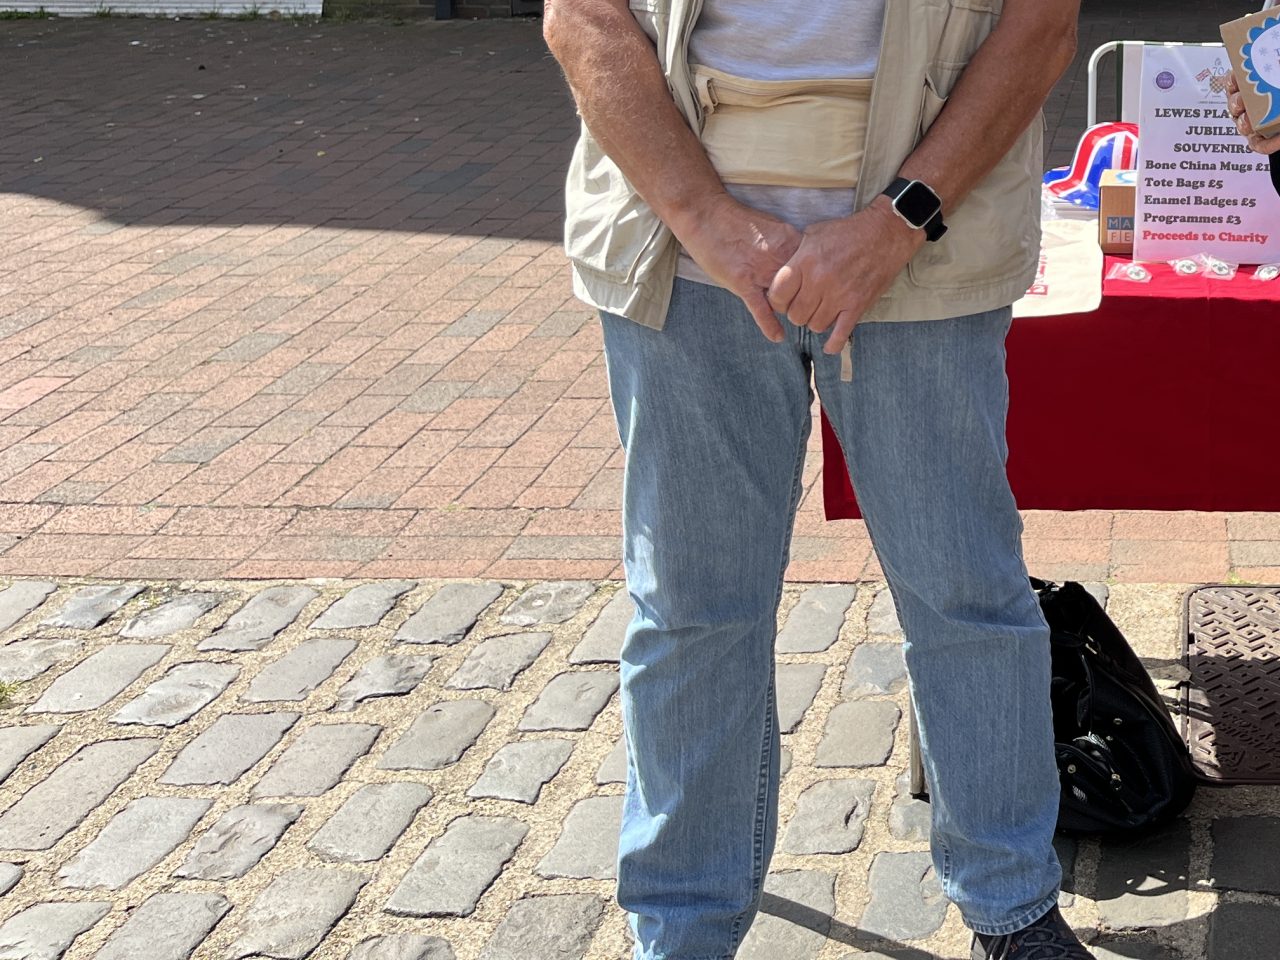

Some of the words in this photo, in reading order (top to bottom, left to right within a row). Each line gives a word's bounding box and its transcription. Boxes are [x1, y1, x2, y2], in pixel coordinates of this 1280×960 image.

[1155, 107, 1201, 119] LEWES
[1203, 108, 1230, 119] PLA
[1173, 142, 1254, 154] SOUVENIRS
[1145, 159, 1177, 170] Bone
[1179, 160, 1217, 171] China
[1219, 161, 1253, 173] Mugs
[1255, 162, 1271, 172] £1
[1144, 177, 1174, 188] Tote
[1176, 178, 1206, 190] Bags
[1208, 179, 1224, 189] £5
[1143, 195, 1191, 206] Enamel
[1194, 196, 1238, 208] Badges
[1241, 197, 1257, 208] £5
[1108, 218, 1133, 229] MA
[1143, 212, 1224, 225] Programmes
[1226, 215, 1242, 225] £3
[1110, 231, 1132, 242] FE
[1142, 230, 1200, 241] Proceeds
[1202, 231, 1216, 242] to
[1218, 232, 1269, 245] Charity
